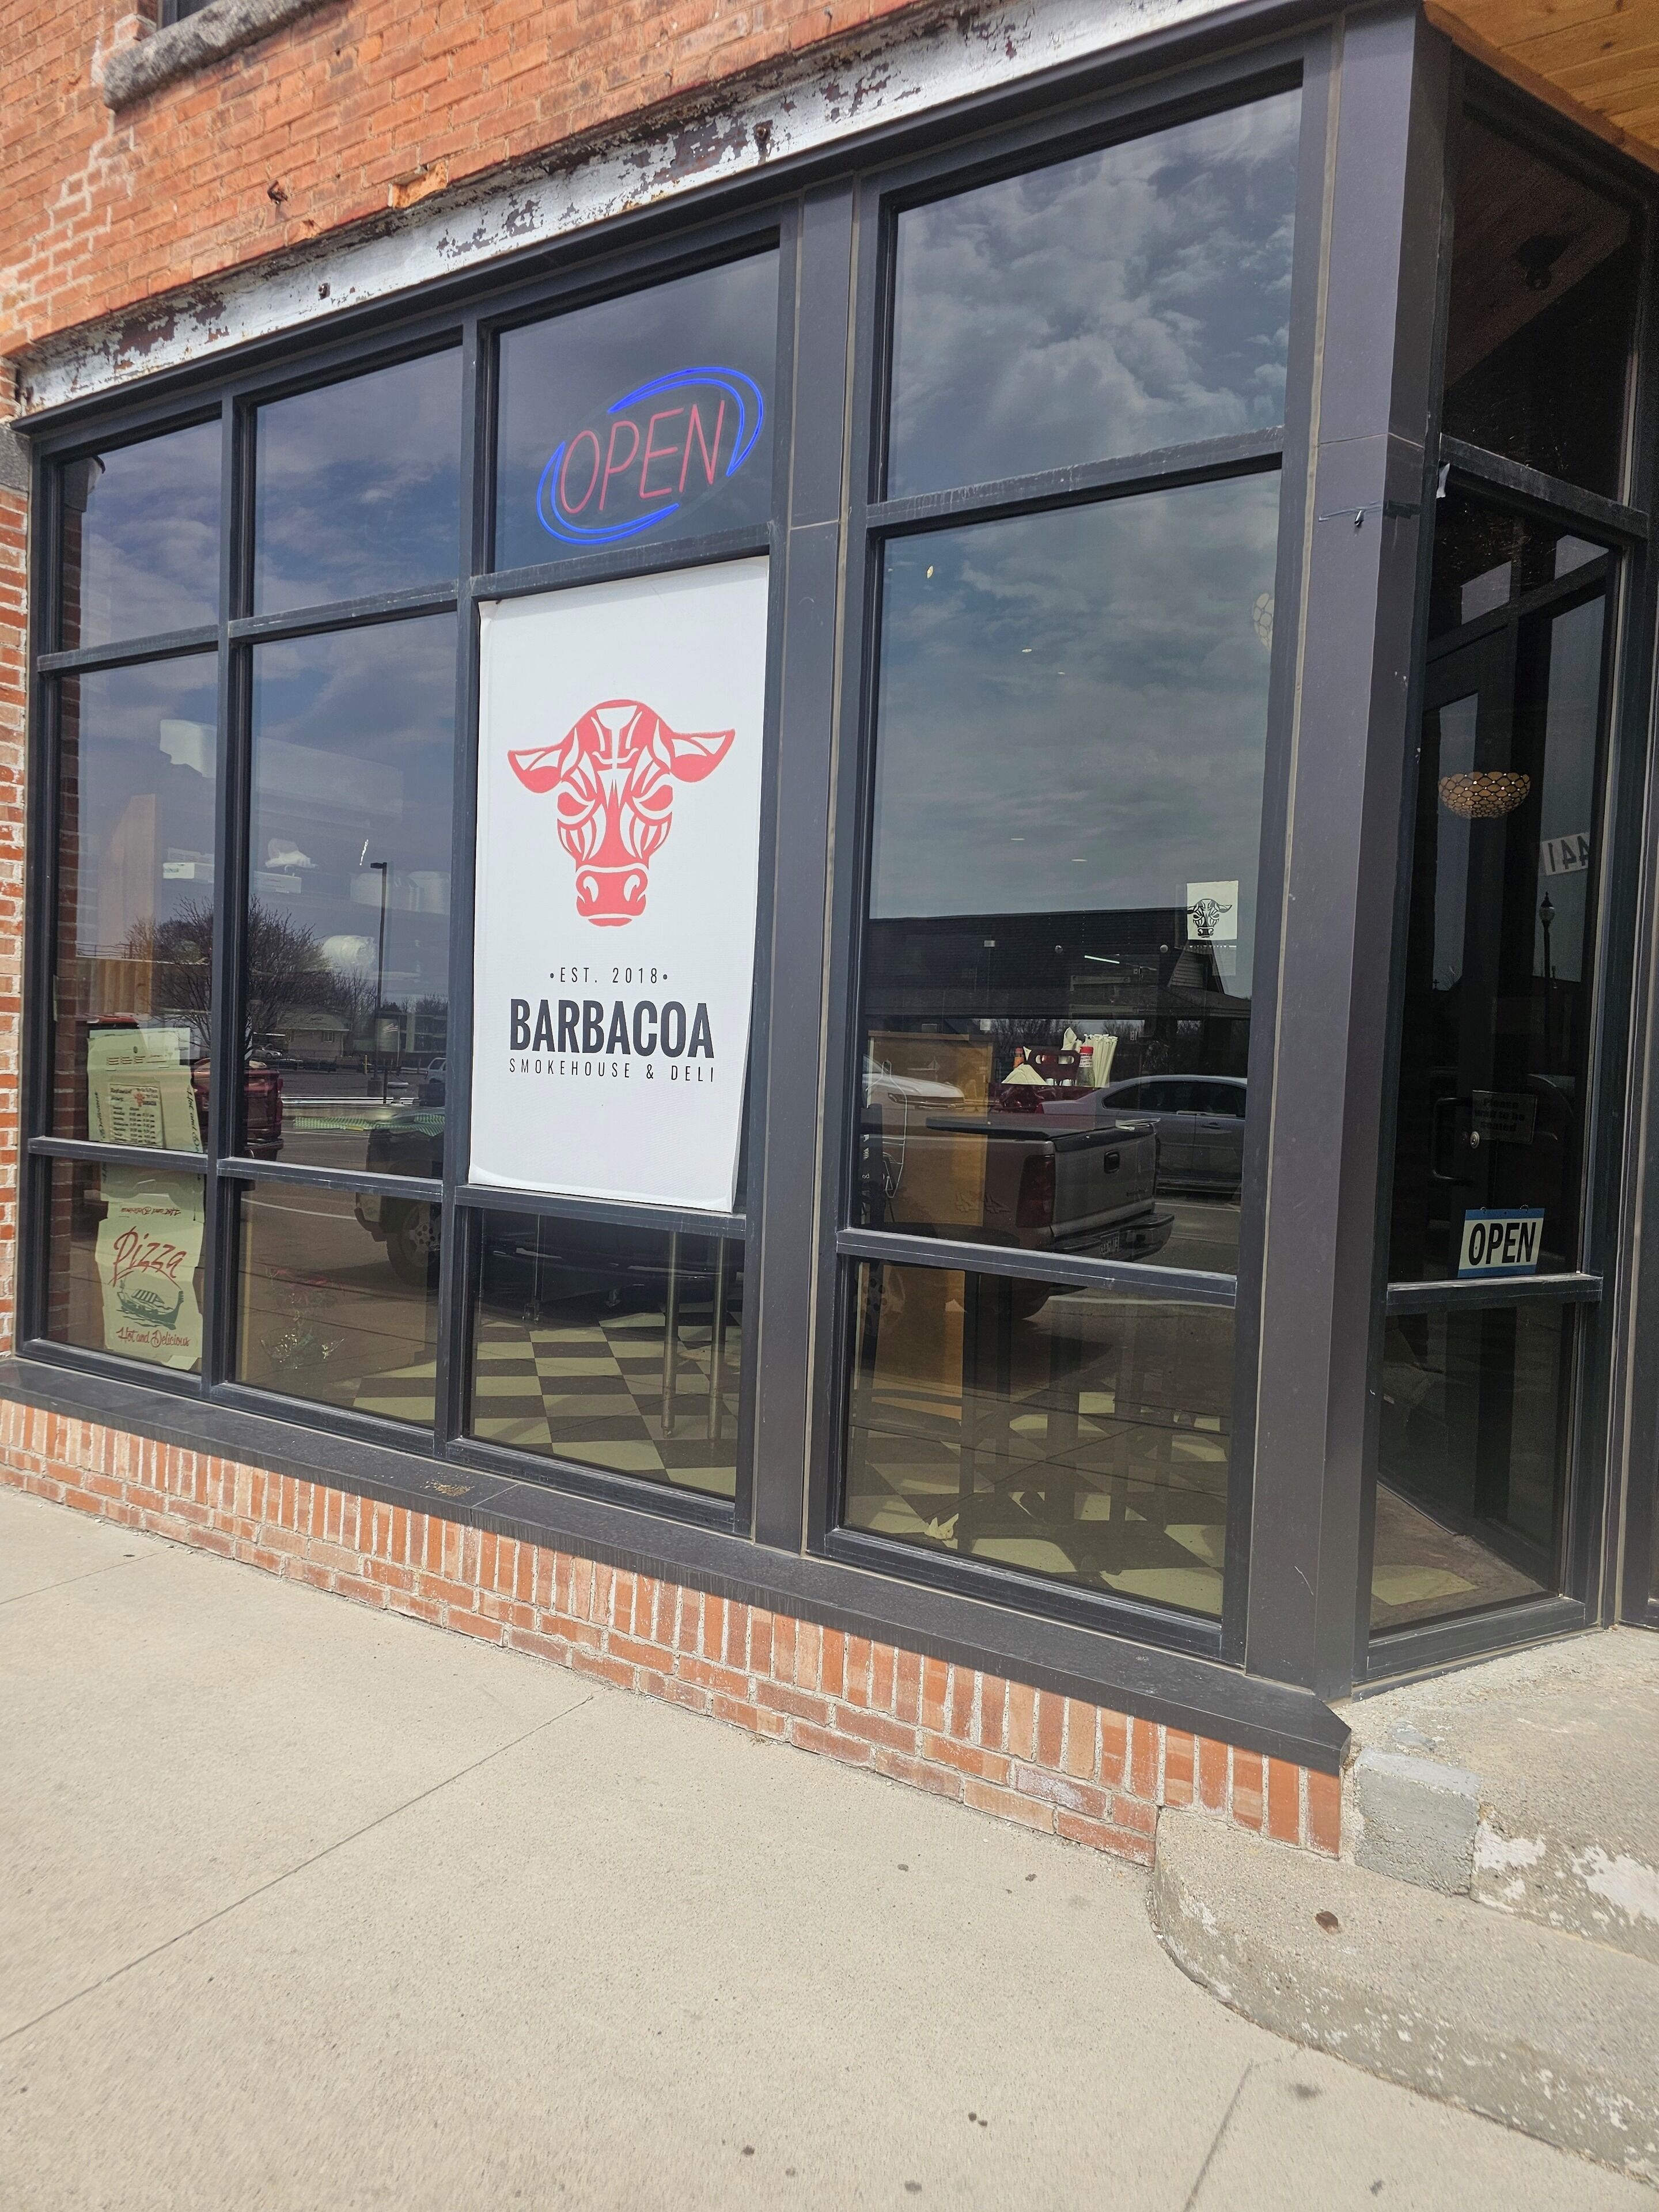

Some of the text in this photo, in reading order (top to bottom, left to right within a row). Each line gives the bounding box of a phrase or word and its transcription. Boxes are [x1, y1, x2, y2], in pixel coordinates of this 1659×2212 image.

[560, 400, 725, 514] OPEN
[560, 967, 657, 984] EST. 2018
[509, 998, 715, 1059] BARBACOA
[509, 1058, 714, 1082] SMOKEHOUSE & DELI
[111, 1226, 187, 1287] Pizza
[1468, 1221, 1537, 1266] OPEN
[116, 1327, 191, 1348] Hot and Delicious
